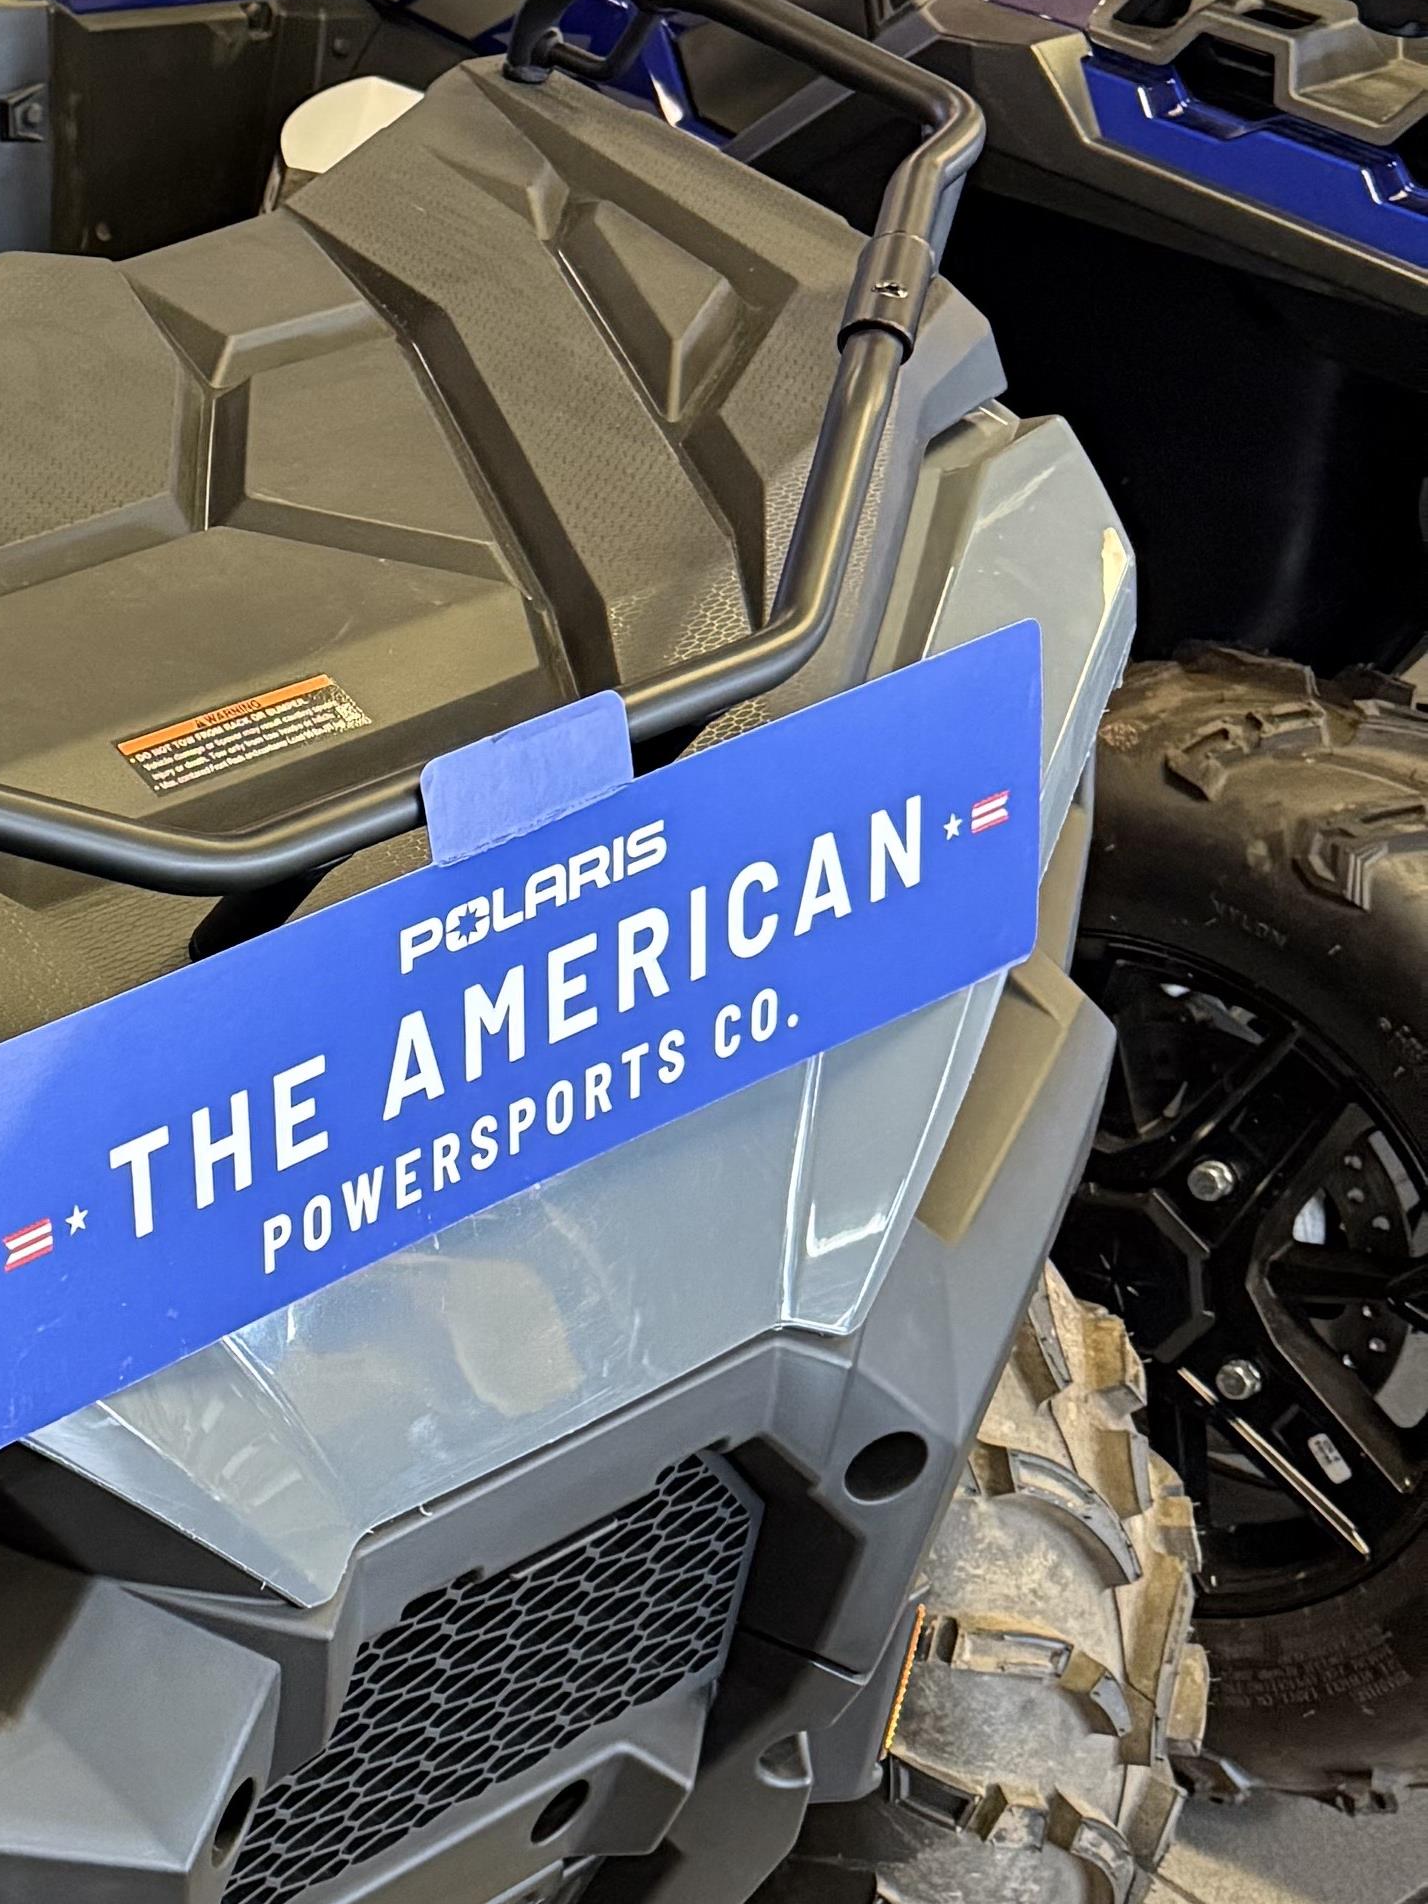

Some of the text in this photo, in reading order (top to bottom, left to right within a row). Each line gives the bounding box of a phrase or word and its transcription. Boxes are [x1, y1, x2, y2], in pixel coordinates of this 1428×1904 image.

[133, 749, 153, 762] DO
[149, 742, 172, 756] NOT
[169, 734, 196, 750] TOW
[193, 724, 225, 741] FROM
[221, 715, 252, 732] RACK
[249, 710, 267, 722] OR
[201, 698, 262, 726] WARNING
[399, 819, 667, 974] POLARIS
[108, 795, 923, 1239] THE AMERICAN
[263, 986, 800, 1275] POWERSPORTS CO.
